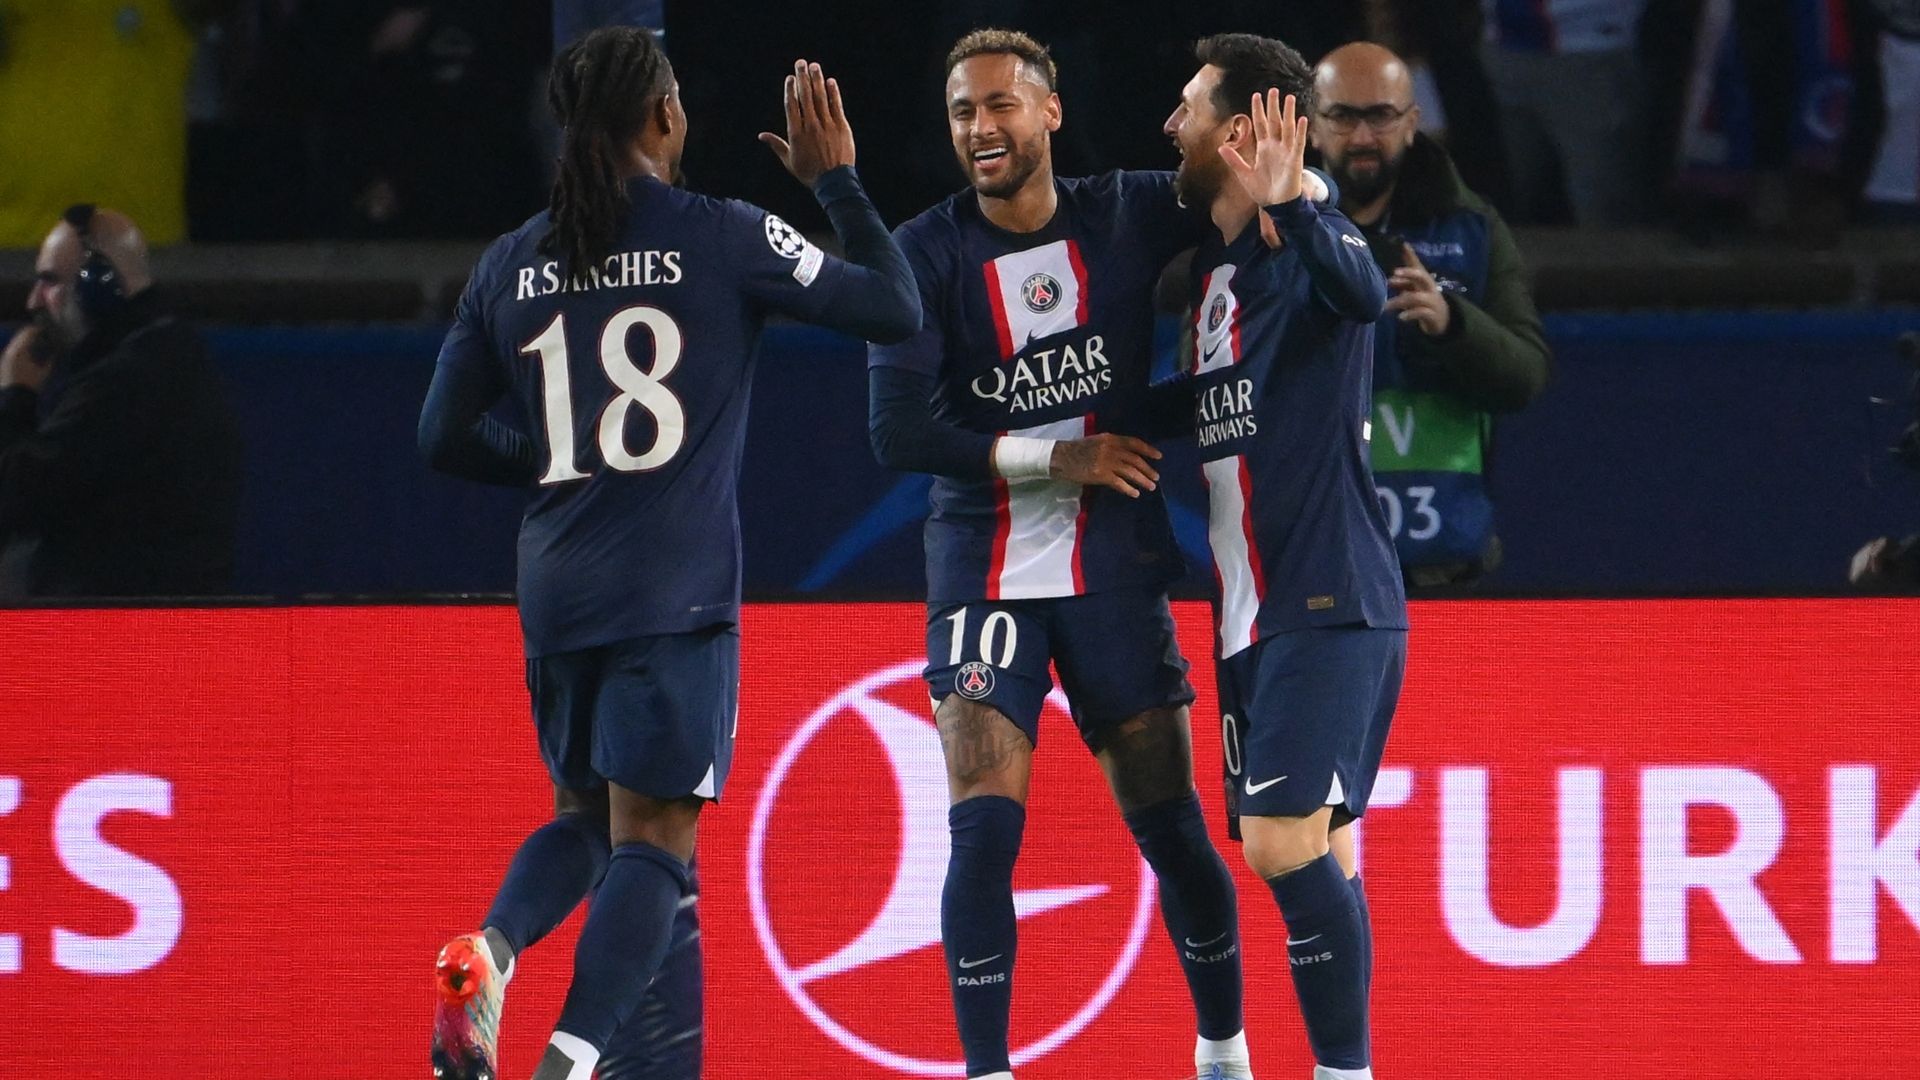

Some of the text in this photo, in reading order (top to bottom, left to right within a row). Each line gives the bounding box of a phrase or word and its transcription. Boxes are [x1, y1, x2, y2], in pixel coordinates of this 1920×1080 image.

[971, 335, 1110, 403] QATAR
[1009, 368, 1112, 413] AIRWAYS
[519, 304, 686, 485] 18
[1196, 378, 1254, 422] ATAR
[1198, 414, 1258, 448] AIRWAYS
[946, 606, 1018, 669] 10
[961, 663, 987, 674] PARIS
[0, 772, 186, 976] S
[1184, 944, 1236, 963] PARIS
[1288, 951, 1333, 967] ARIS
[957, 972, 1006, 986] PARIS
